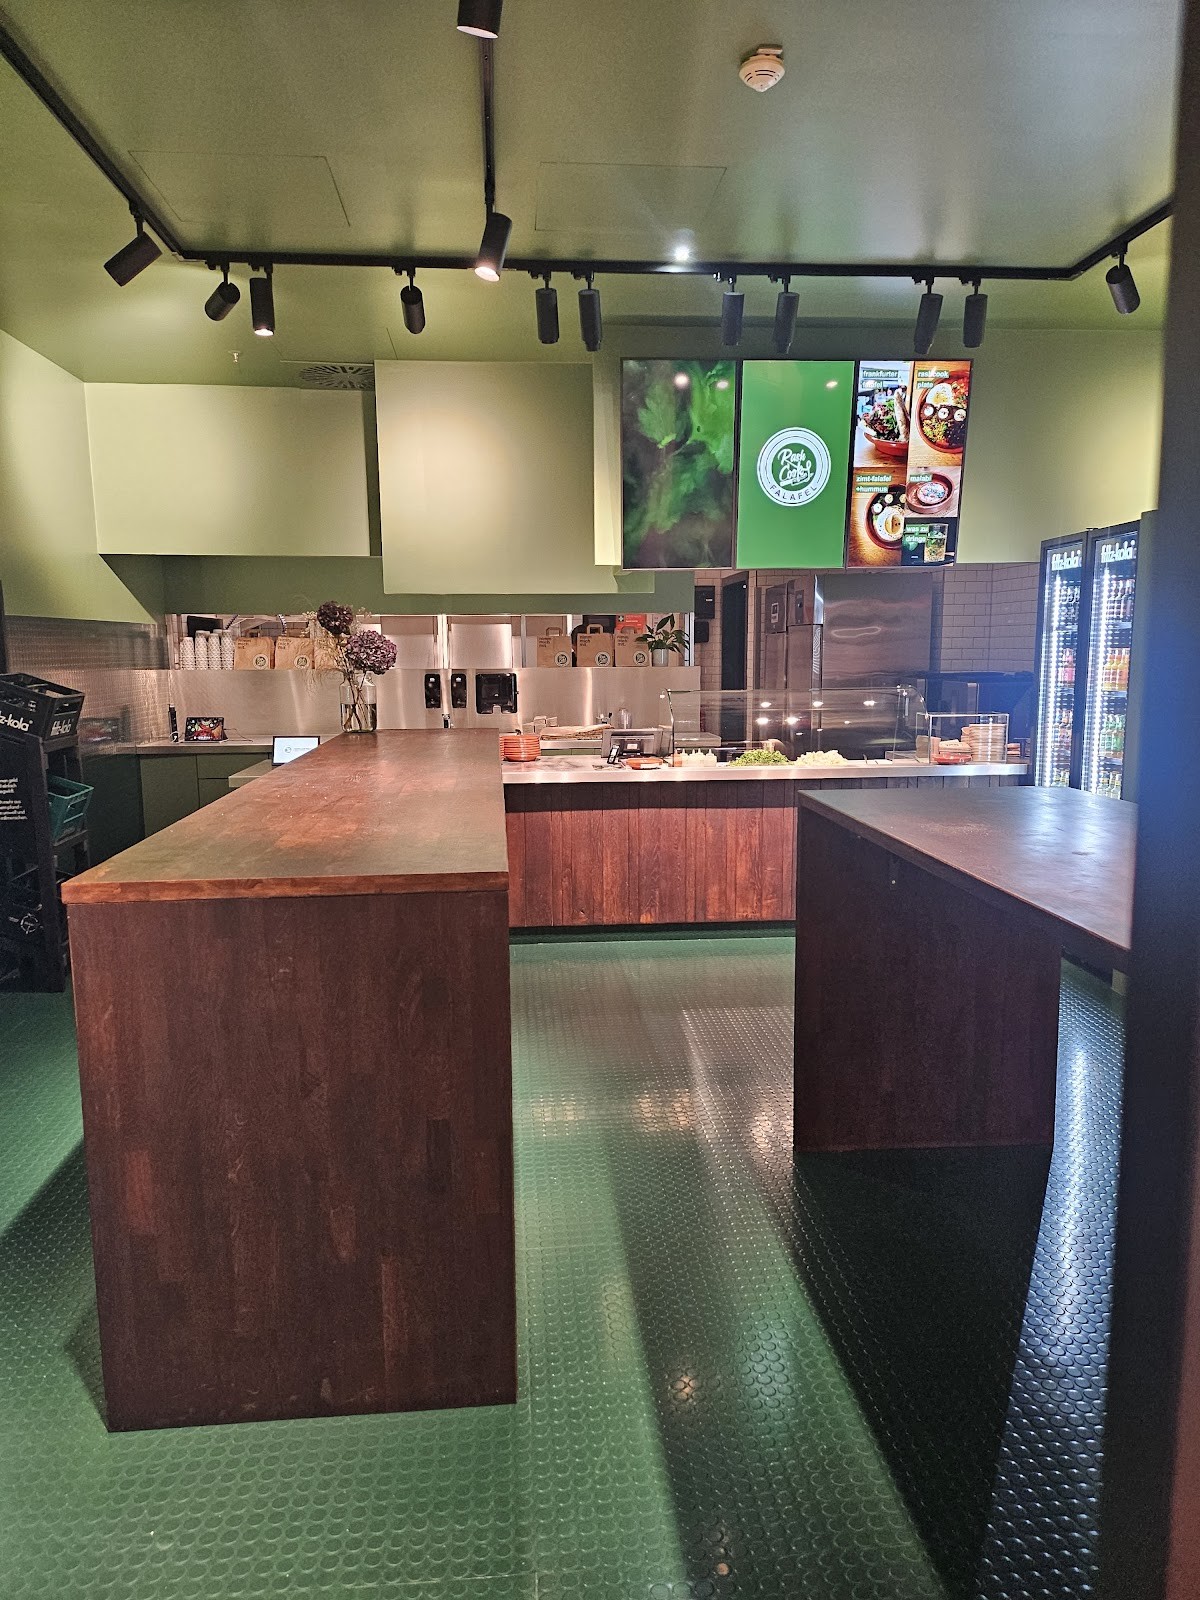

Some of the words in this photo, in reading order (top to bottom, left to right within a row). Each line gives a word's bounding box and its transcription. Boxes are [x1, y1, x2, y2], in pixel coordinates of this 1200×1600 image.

[863, 370, 898, 378] frankfurter
[933, 370, 949, 378] cook
[917, 381, 934, 389] plate
[778, 448, 806, 466] Rash
[769, 484, 817, 501] FALAFEL
[0, 710, 30, 732] z-kola
